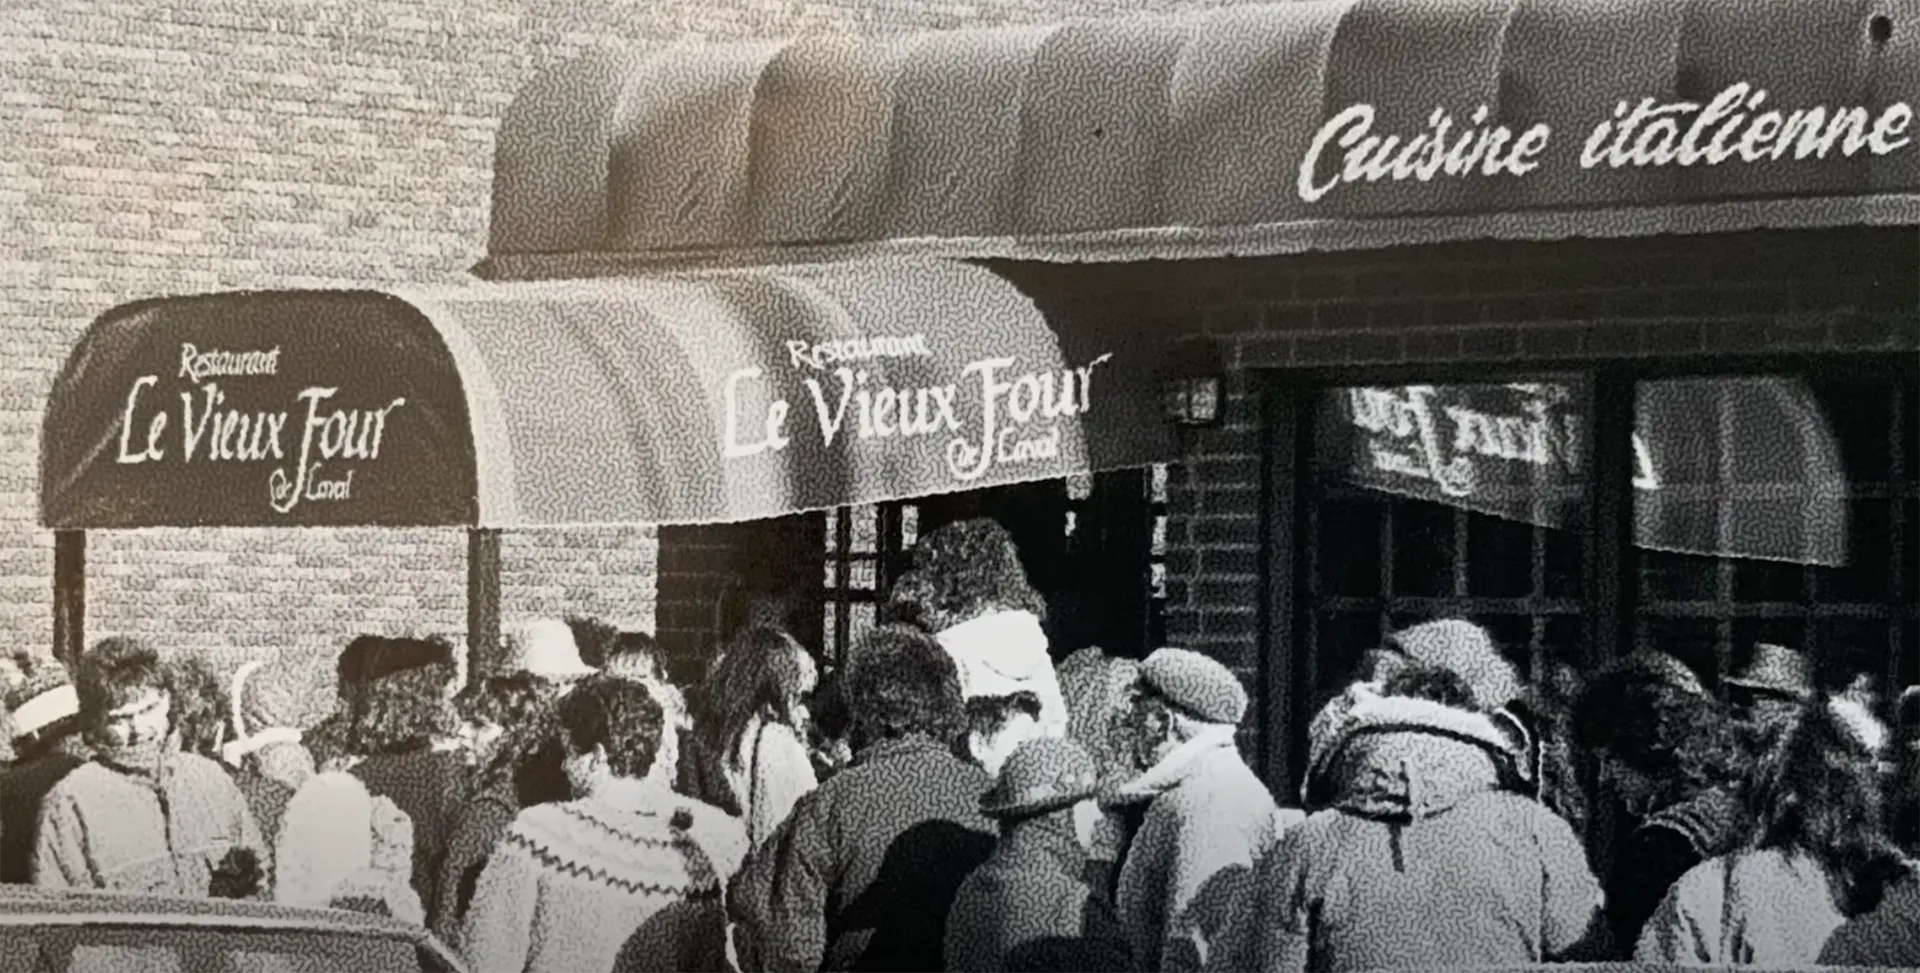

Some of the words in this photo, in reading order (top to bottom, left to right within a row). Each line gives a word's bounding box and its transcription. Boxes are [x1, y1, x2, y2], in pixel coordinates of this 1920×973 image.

[1298, 103, 1550, 201] Cuisine
[1580, 82, 1912, 168] italienne
[178, 341, 281, 384] Restaurant
[786, 332, 932, 370] Restaurant
[724, 368, 790, 457] Le
[806, 366, 962, 448] Vieux
[948, 353, 1113, 480] Four
[117, 375, 167, 463] Le
[181, 383, 288, 463] Vieux
[271, 386, 405, 513] Four
[997, 427, 1058, 463] Laval
[305, 462, 353, 500] Laval
